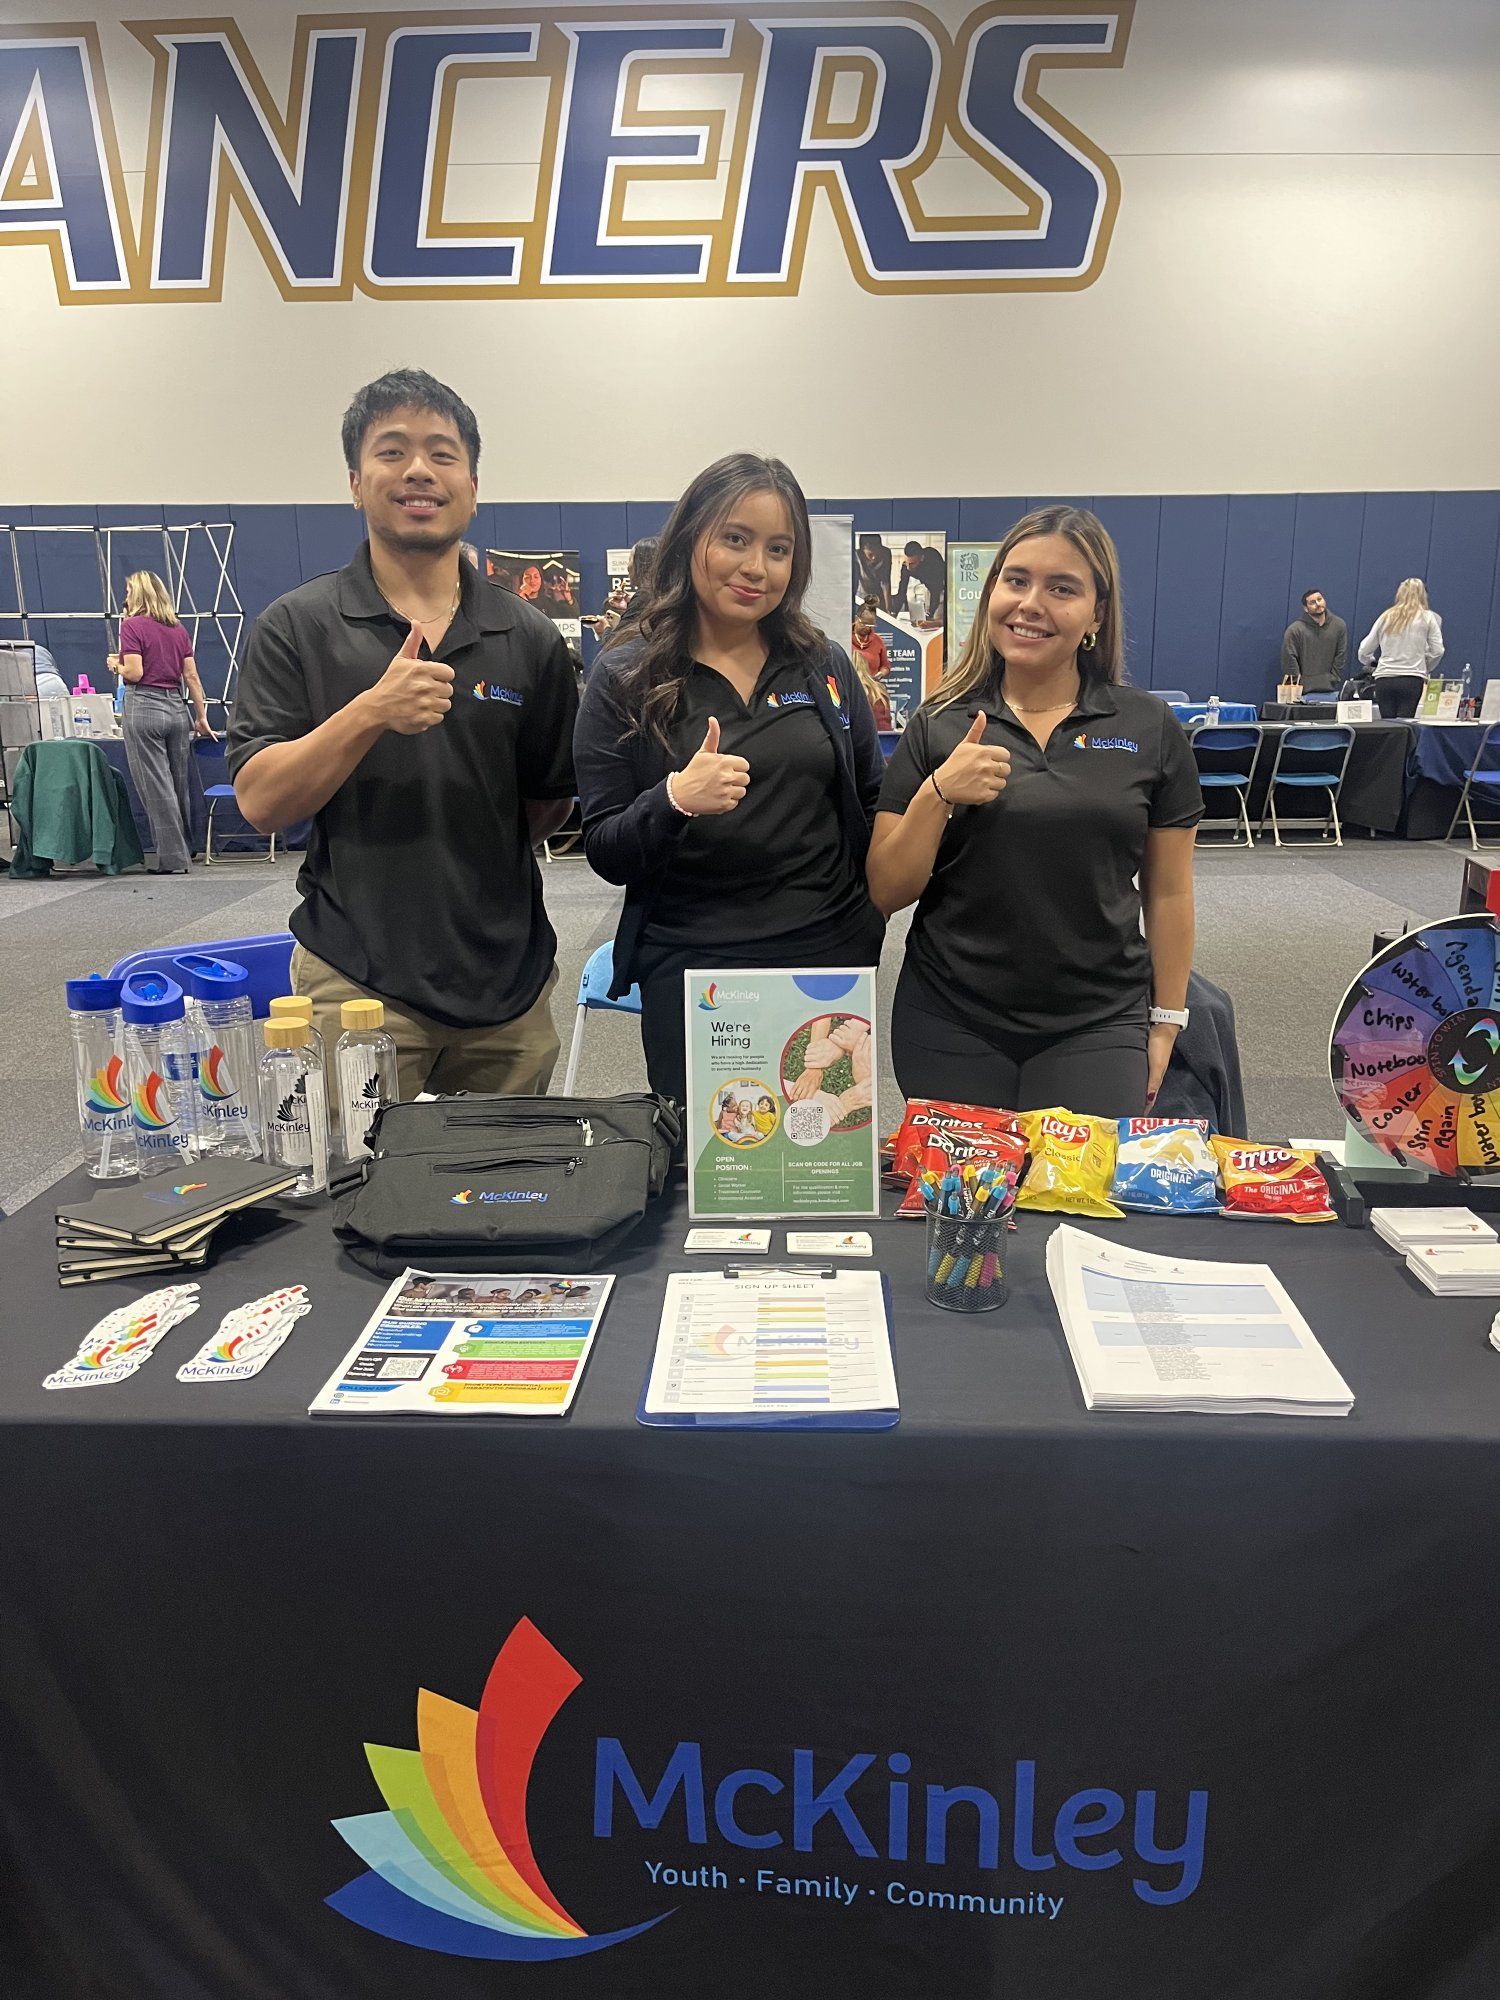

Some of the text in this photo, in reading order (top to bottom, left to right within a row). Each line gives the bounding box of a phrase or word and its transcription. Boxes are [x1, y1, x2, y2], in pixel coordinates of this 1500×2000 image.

[961, 571, 978, 581] IRS
[1092, 737, 1138, 752] McKinley
[1391, 961, 1434, 999] Water
[717, 990, 760, 1002] McKinley
[711, 1021, 751, 1032] We're
[1363, 1007, 1414, 1031] Chips
[711, 1035, 751, 1049] Hiring
[202, 1104, 248, 1119] cKinley
[1372, 1082, 1422, 1130] Cooler
[267, 1121, 310, 1133] McKinley
[912, 1115, 984, 1129] Doritos
[1434, 1105, 1456, 1149] Again
[1407, 1118, 1433, 1150] Spin
[927, 1133, 999, 1158] Doritos
[1045, 1148, 1081, 1161] Classic
[1229, 1149, 1297, 1170] Frito
[1151, 1168, 1192, 1184] ORIGINAL
[1260, 1183, 1301, 1195] ORIGINAL
[479, 1191, 548, 1203] McKinley
[47, 1370, 124, 1385] McKinley
[181, 1365, 254, 1376] McKinley
[594, 1737, 1208, 1905] McKinley
[645, 1861, 1065, 1920] Youth Family Community
